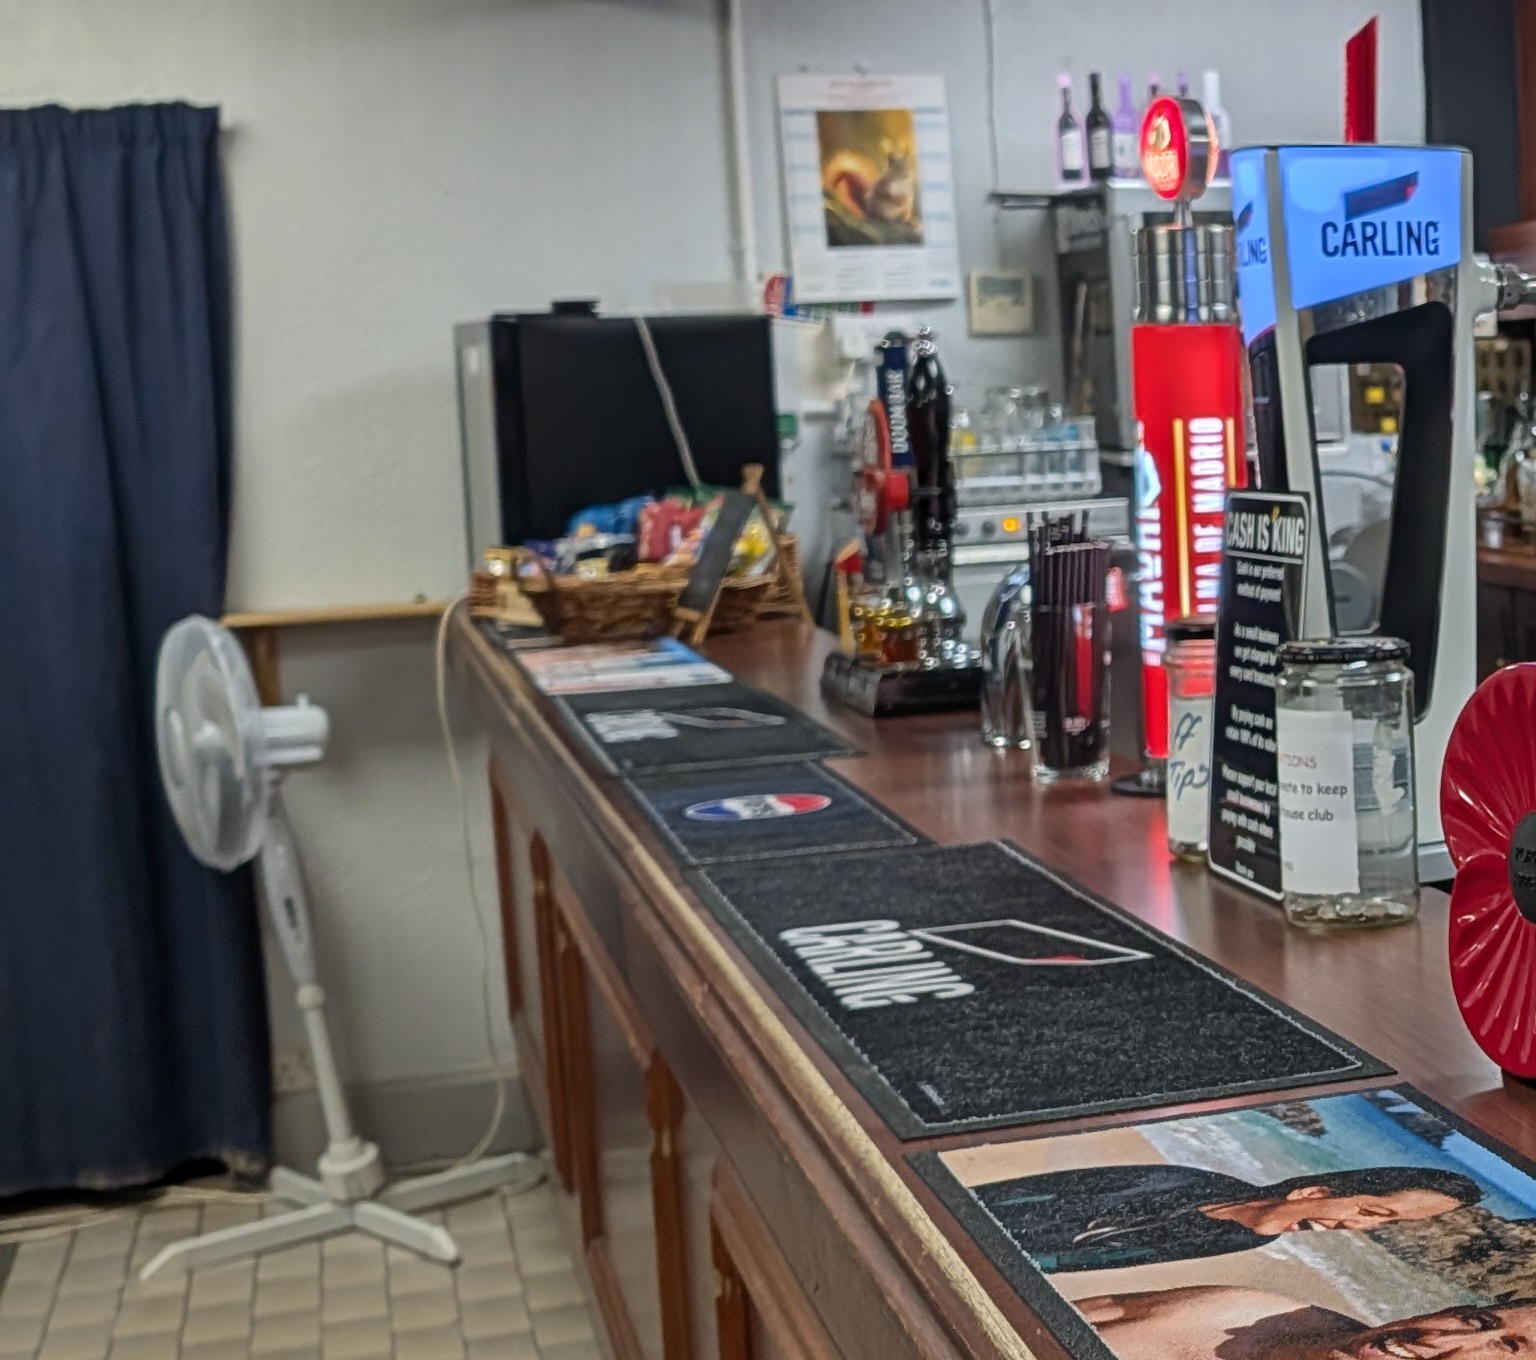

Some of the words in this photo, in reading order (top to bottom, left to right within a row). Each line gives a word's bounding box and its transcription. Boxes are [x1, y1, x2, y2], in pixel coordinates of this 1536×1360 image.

[1321, 220, 1440, 258] CARLING
[1189, 416, 1225, 513] MADRID
[1227, 510, 1255, 550] CASH
[1257, 513, 1270, 552] IS
[1271, 514, 1305, 556] KING
[1301, 783, 1313, 795] to
[1317, 782, 1348, 798] keep
[1308, 807, 1334, 821] club
[778, 918, 976, 1012] CARLING
